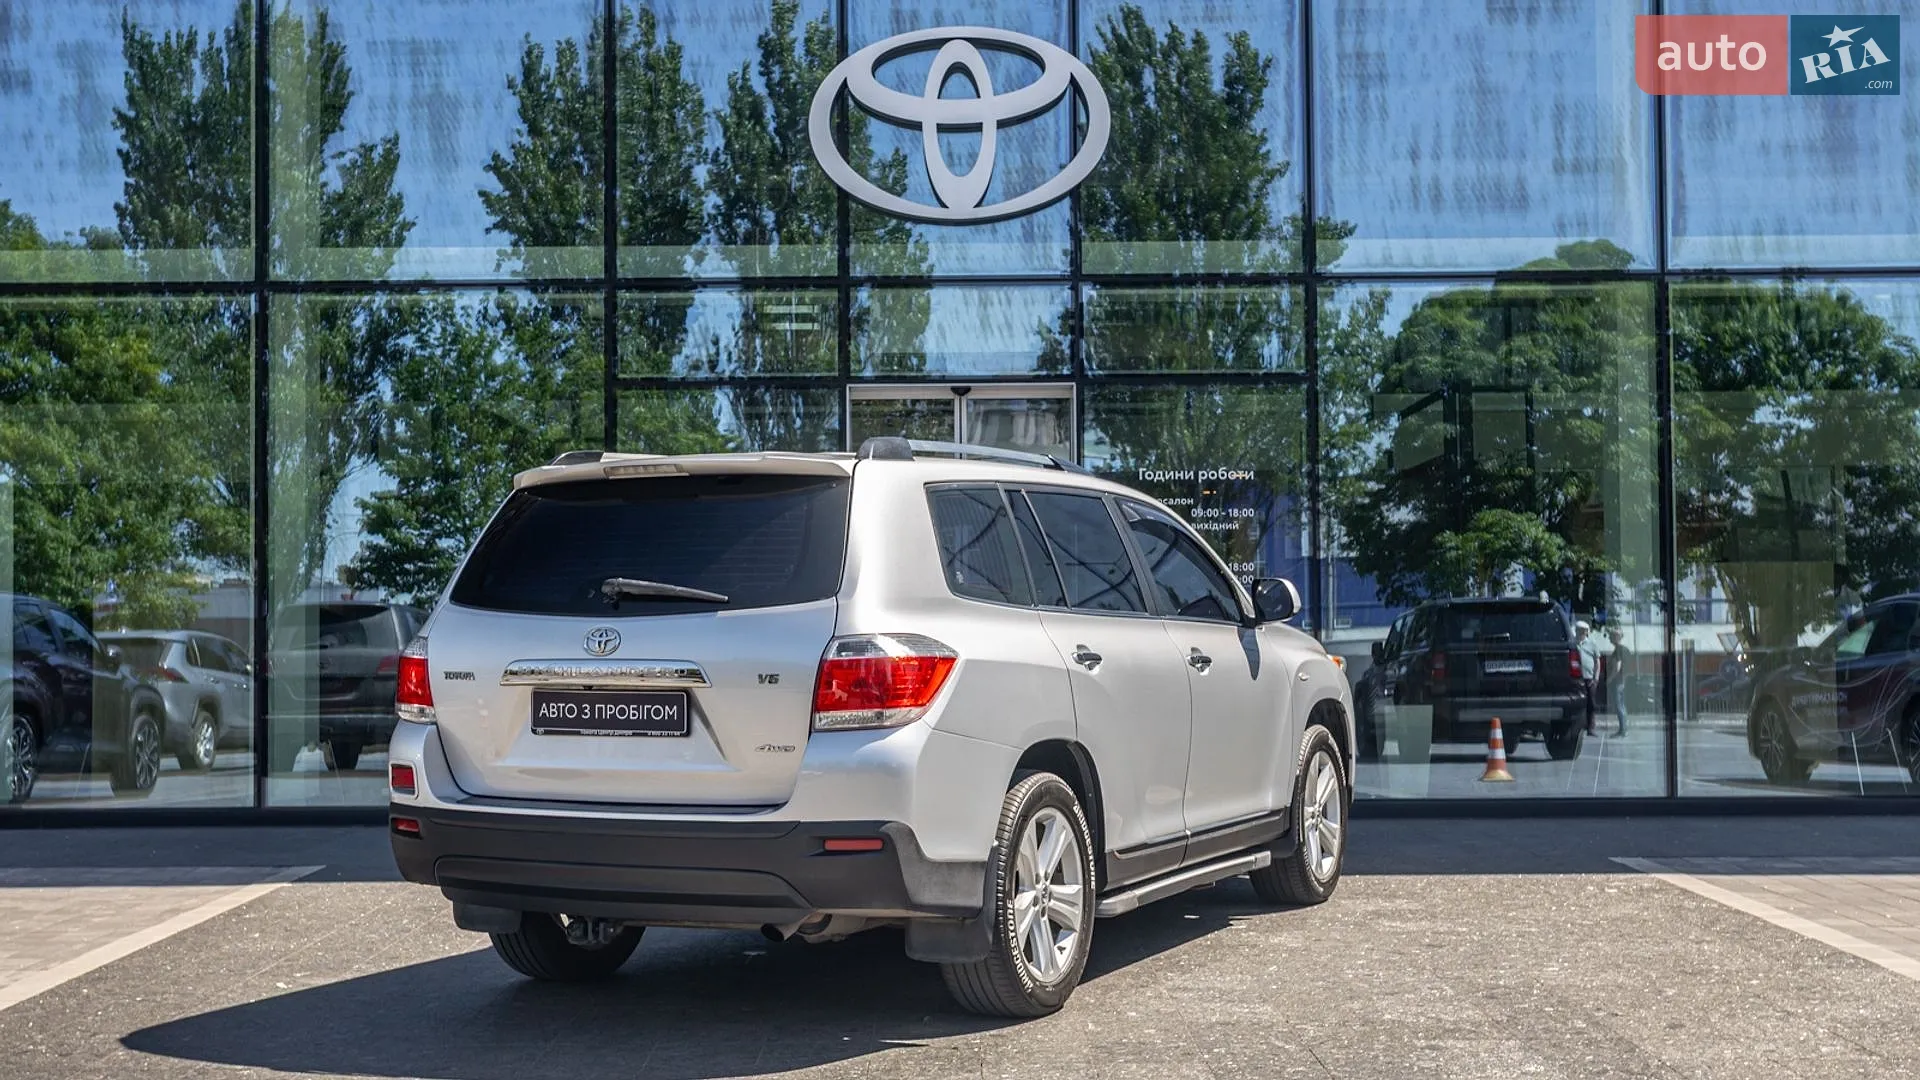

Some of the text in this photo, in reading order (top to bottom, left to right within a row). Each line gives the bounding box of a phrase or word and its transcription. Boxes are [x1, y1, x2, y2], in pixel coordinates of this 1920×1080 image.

[1138, 466, 1255, 484] Години роботи
[1191, 508, 1219, 518] 09:00
[1228, 508, 1255, 518] 18:00
[757, 673, 780, 685] V6
[538, 702, 579, 720] АВТО
[595, 703, 678, 721] ПРОБІГОМ
